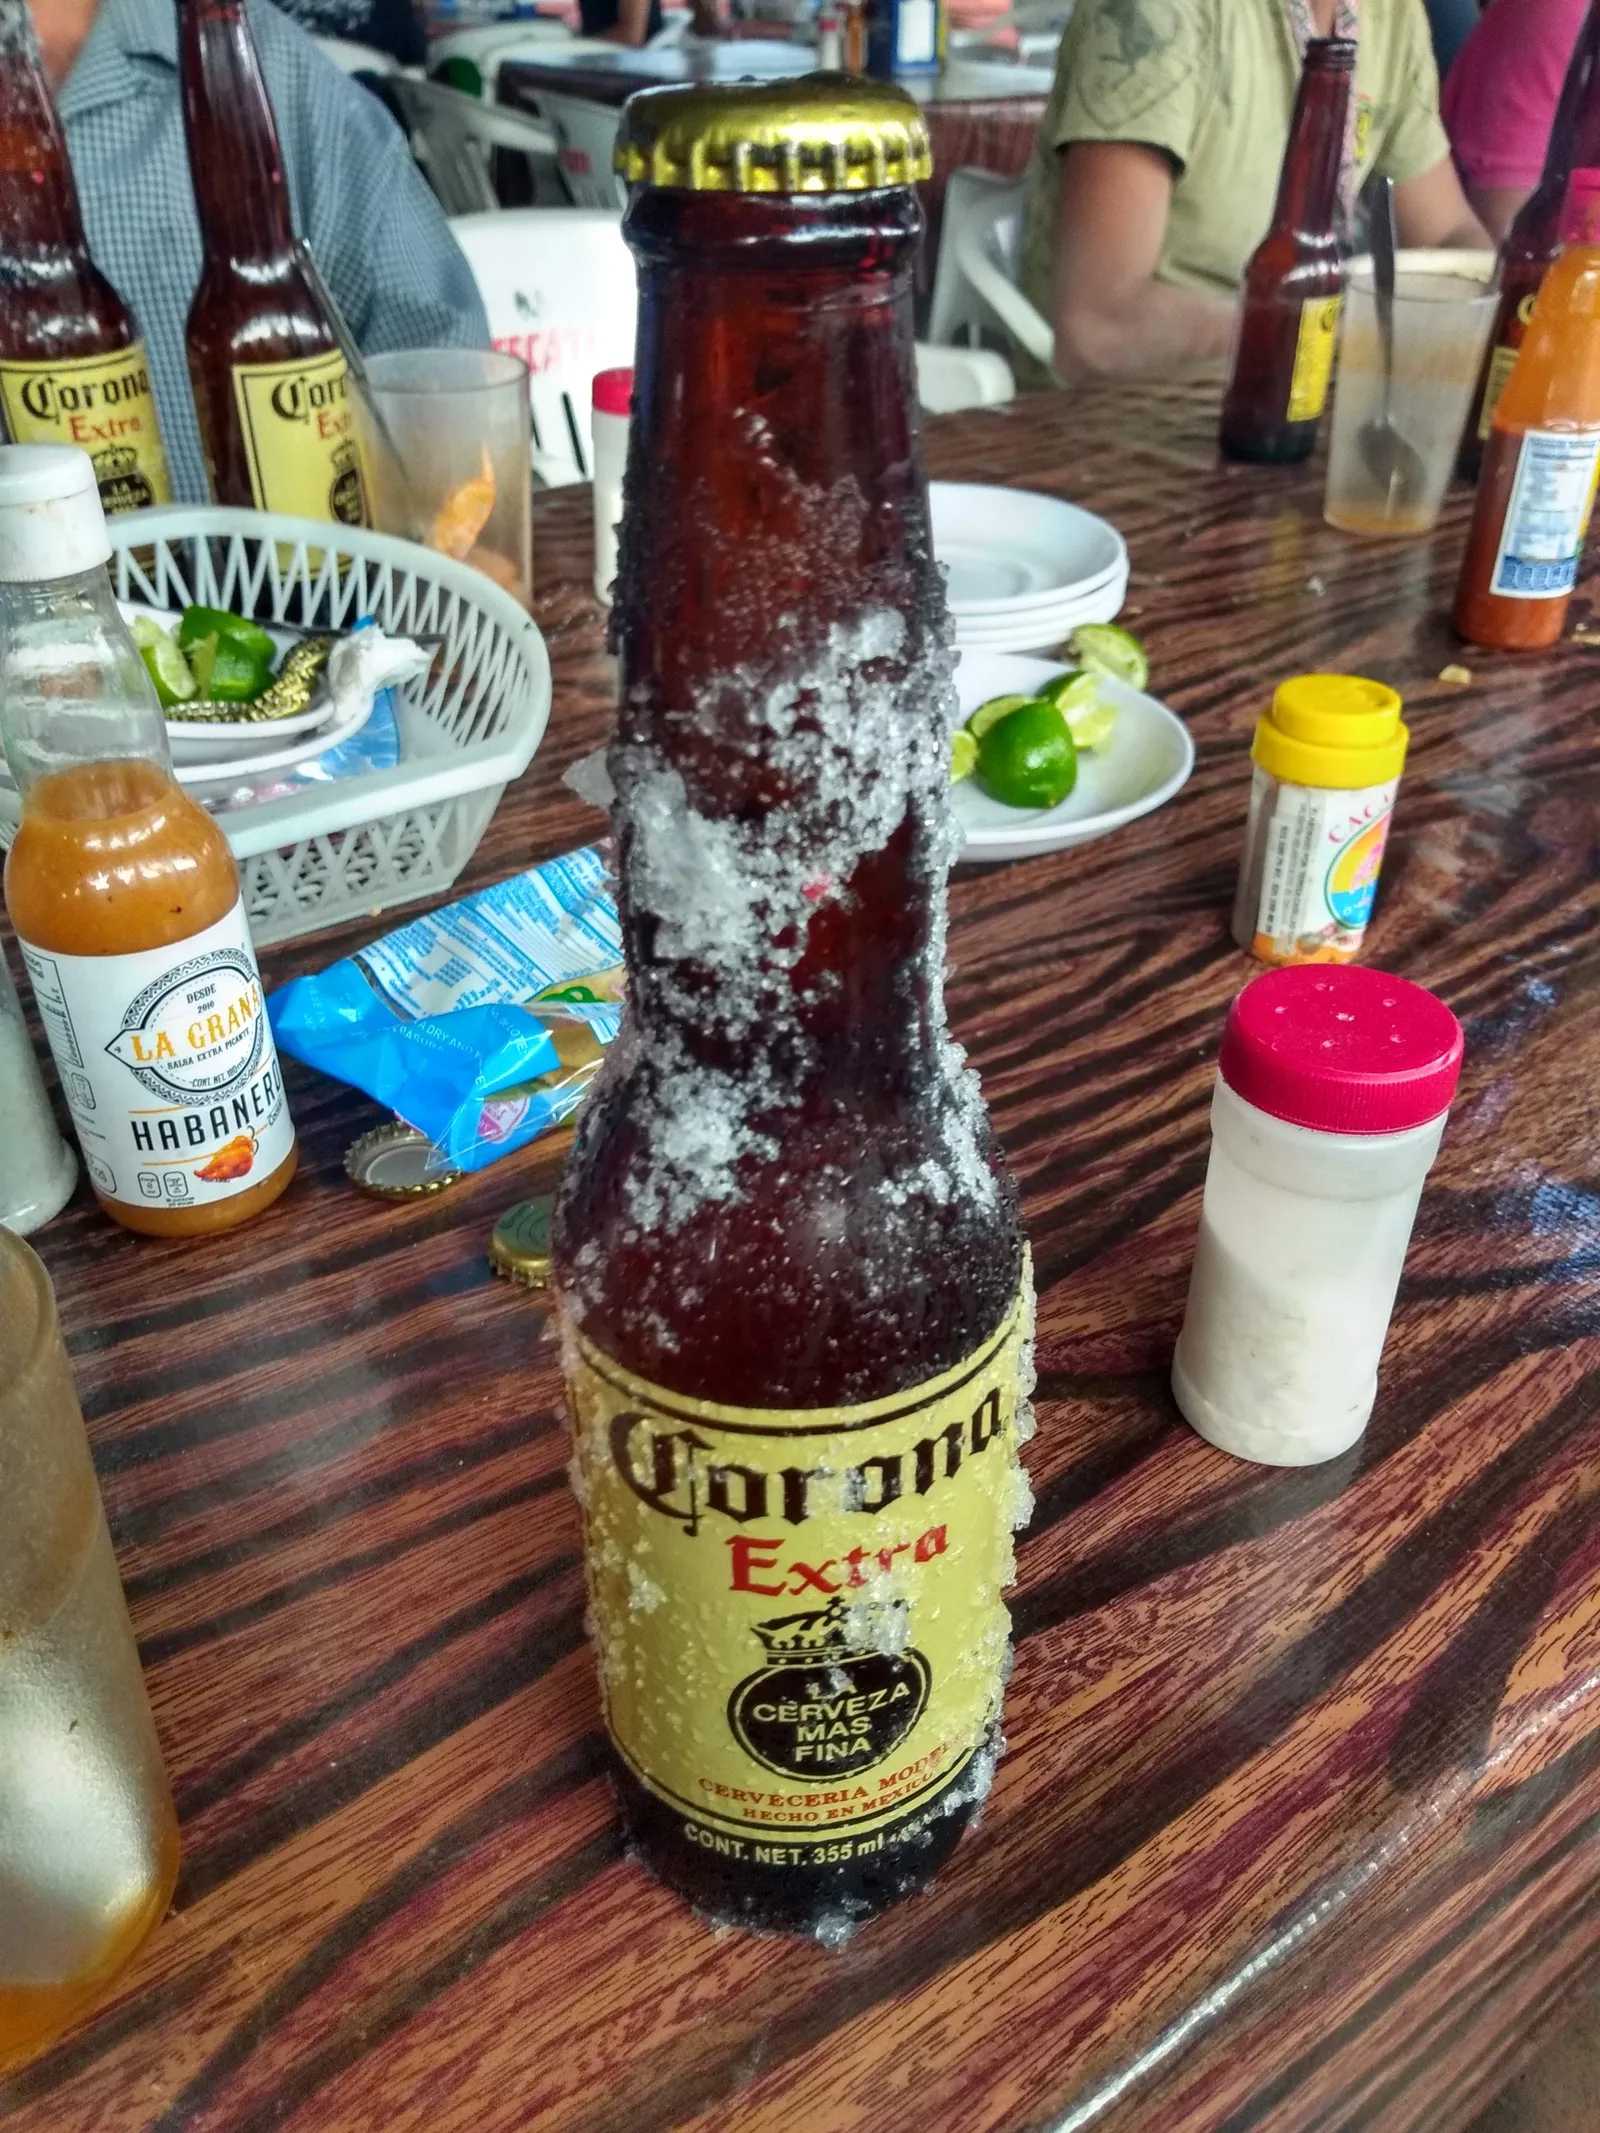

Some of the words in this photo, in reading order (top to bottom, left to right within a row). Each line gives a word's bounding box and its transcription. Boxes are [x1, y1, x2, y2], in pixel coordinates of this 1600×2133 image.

[186, 984, 217, 1005] DESDE
[197, 1000, 215, 1014] 2010
[130, 1032, 177, 1062] LA
[426, 1023, 449, 1042] DRY
[449, 1036, 474, 1055] AND
[167, 1057, 195, 1071] SALSA
[197, 1046, 223, 1063] EXTRA
[130, 1059, 282, 1151] HABANERO
[610, 1386, 1002, 1537] Corona
[725, 1523, 950, 1597] Extra
[752, 1682, 911, 1723] CERVEZA
[797, 1716, 873, 1742] MAS
[795, 1736, 873, 1762] FINA
[698, 1777, 869, 1809] CERVECERIA
[742, 1807, 820, 1823] HECHO
[825, 1804, 855, 1819] EN
[861, 1772, 933, 1812] MEXICO
[683, 1822, 749, 1861] CONT.
[755, 1847, 808, 1866] NET.
[814, 1843, 853, 1865] 355
[856, 1832, 884, 1857] ml
